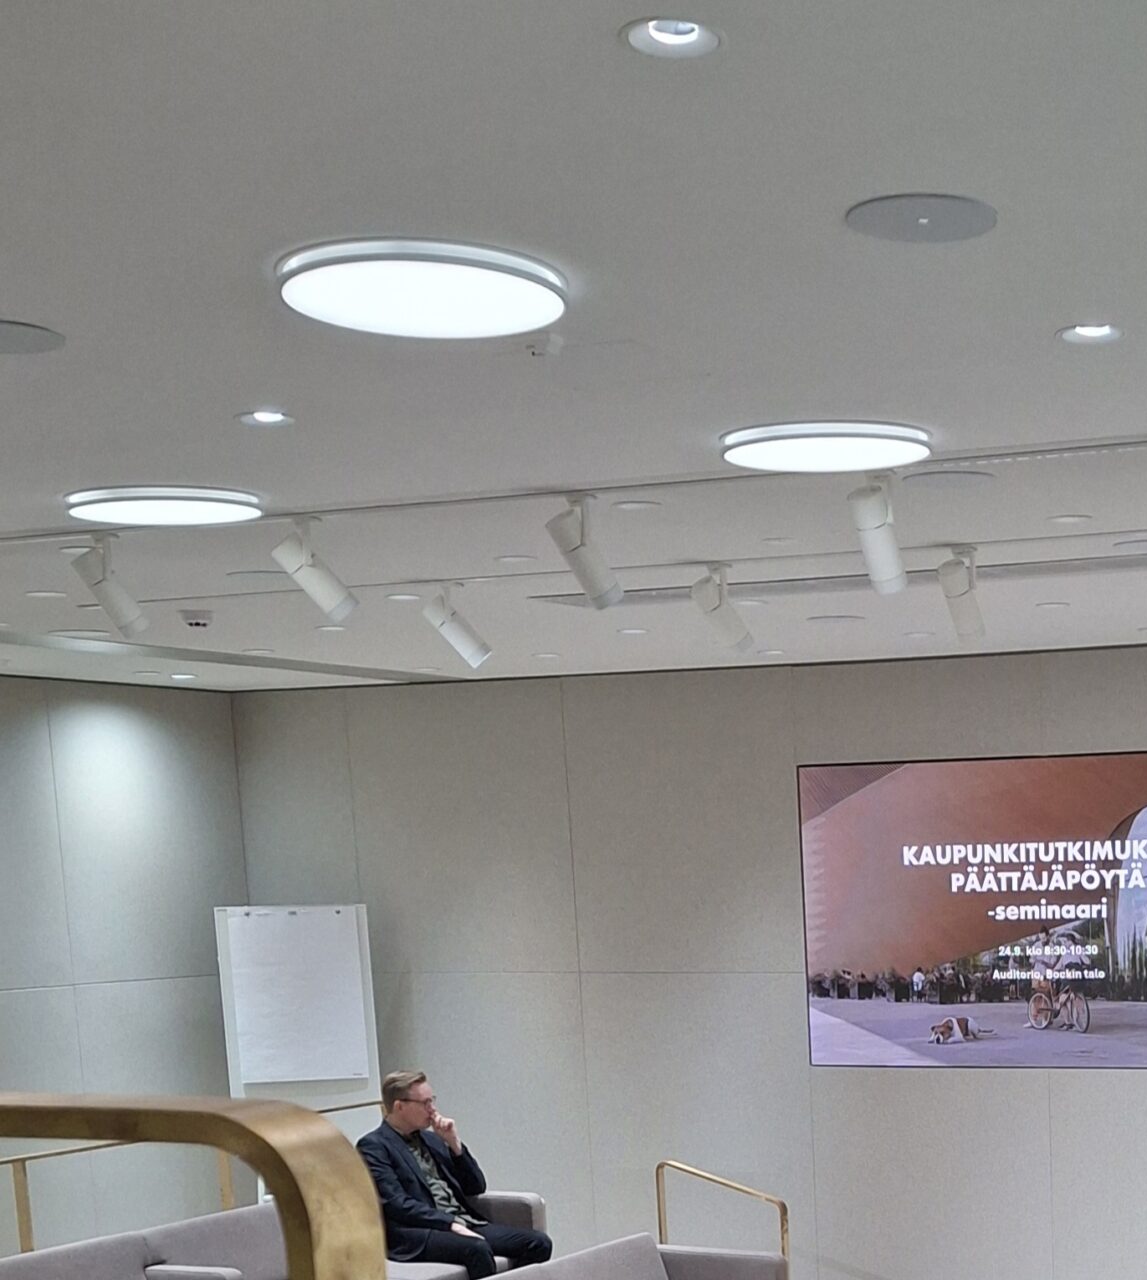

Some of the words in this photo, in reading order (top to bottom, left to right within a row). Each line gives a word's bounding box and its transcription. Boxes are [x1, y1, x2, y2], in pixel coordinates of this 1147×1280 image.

[951, 863, 1146, 892] PÄÄTTÄJÄPÖYTÄ
[988, 897, 1107, 920] -seminaari
[1026, 946, 1042, 956] klo
[1044, 945, 1098, 956] 8:30-10:30
[993, 969, 1044, 981] Auditorio,
[1084, 968, 1106, 979] talo
